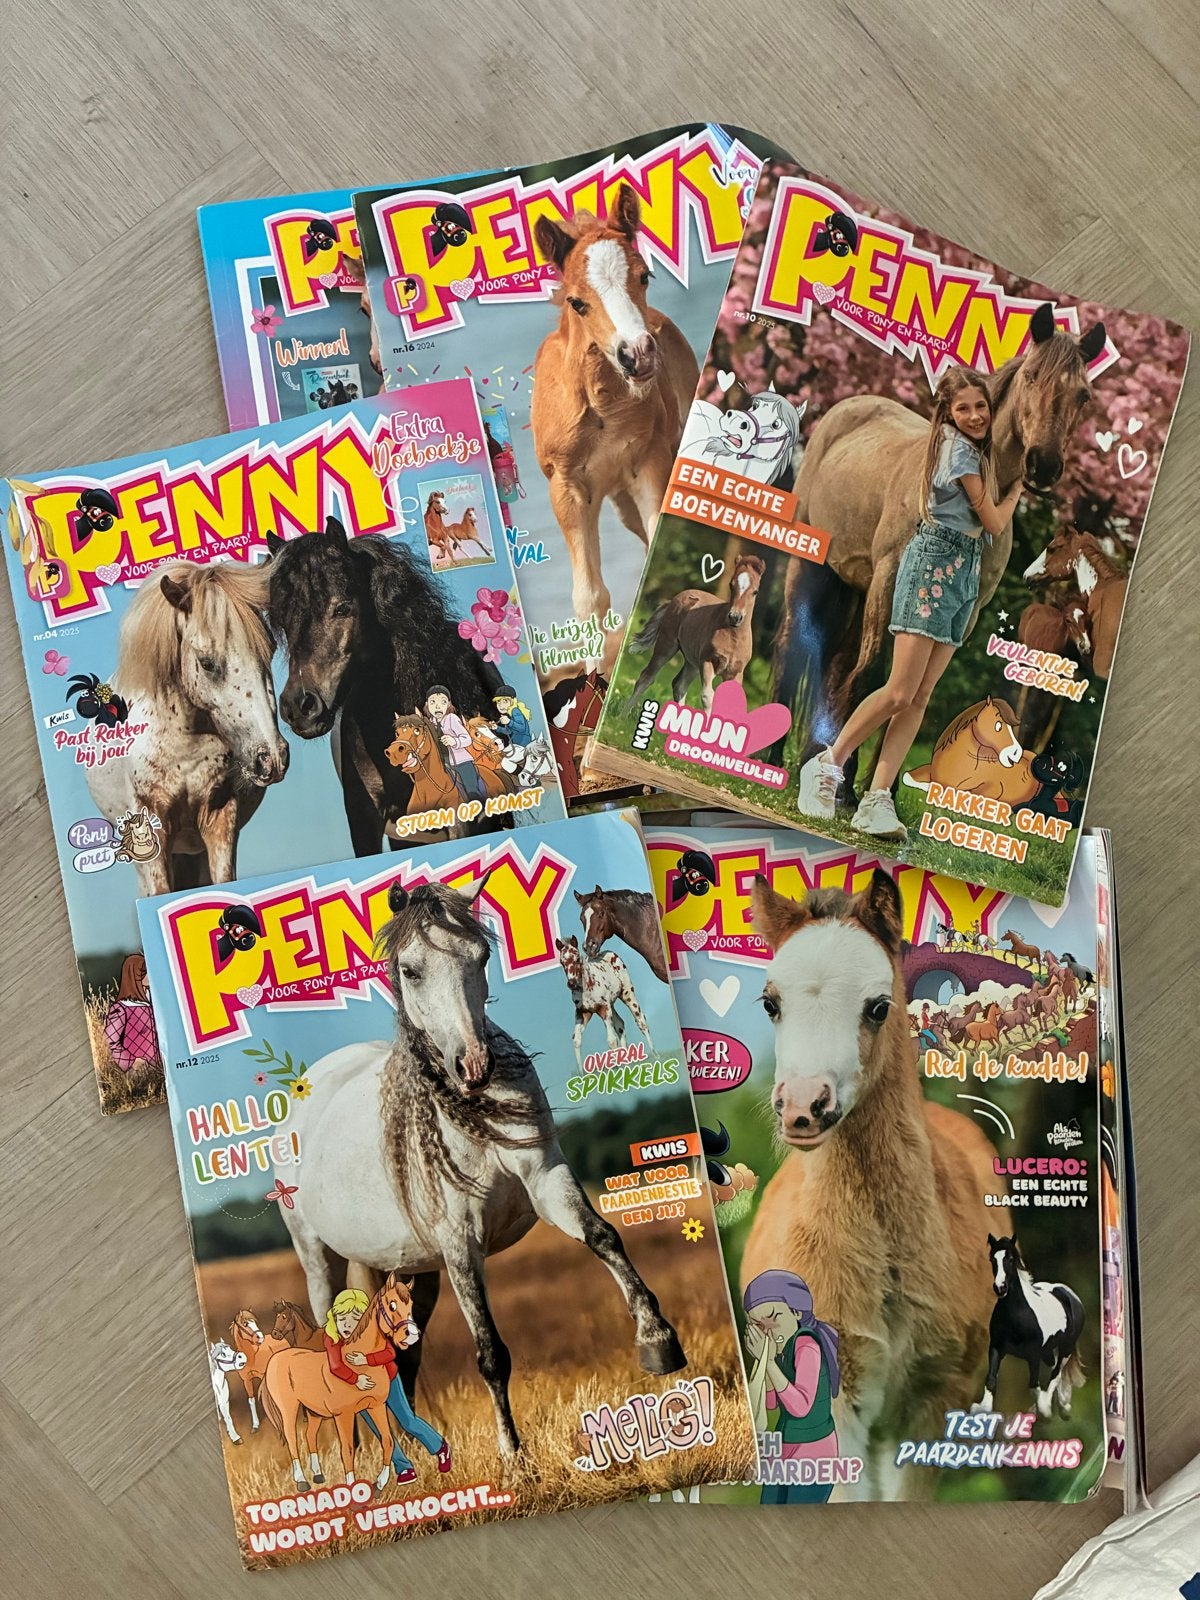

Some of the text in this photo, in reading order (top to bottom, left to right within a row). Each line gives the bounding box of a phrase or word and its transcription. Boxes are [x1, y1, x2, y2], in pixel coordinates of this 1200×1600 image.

[478, 265, 556, 294] VOOR PONY E
[762, 187, 1110, 372] PENN
[733, 310, 775, 330] nr.10 2025
[836, 299, 951, 352] VOOR PONY EN PAARD!
[276, 329, 350, 367] Winnen!
[392, 342, 435, 354] nr.16 2024
[391, 412, 443, 442] Extra
[373, 433, 480, 476] Doeboekje
[677, 464, 785, 514] EEN ECHTE
[25, 430, 398, 618] PENNY
[669, 491, 820, 557] BOEVENVANGER
[124, 562, 154, 578] VOOR
[193, 547, 209, 559] EN
[212, 533, 252, 553] PAARD!
[33, 627, 80, 642] nr.04 2025
[552, 615, 597, 644] krijgt
[604, 610, 621, 628] de
[540, 633, 603, 673] filmrol?
[989, 635, 1078, 675] VEULENTJE
[1005, 664, 1088, 701] GEBOREN!
[49, 712, 70, 726] Kwis
[634, 702, 659, 748] KWIS
[659, 704, 748, 753] MIJN
[55, 722, 148, 748] Past Rakker
[76, 738, 134, 767] bij jou?
[668, 738, 785, 785] DROOMVEULEN
[397, 788, 542, 835] STORM OP KOMST
[927, 783, 1071, 842] RAKKER GAAT
[71, 824, 108, 846] Pony
[920, 814, 1027, 862] LOGEREN
[79, 851, 110, 871] pret
[169, 855, 566, 1043] PENY
[711, 936, 768, 948] VOOR PO
[267, 984, 300, 1000] VOOR
[303, 974, 336, 991] PONY
[341, 970, 357, 982] EN
[175, 1055, 220, 1070] nr.12 2025
[583, 1044, 647, 1073] OVERAL
[687, 1039, 730, 1063] KER
[926, 1050, 1088, 1082] Red de kudde!
[567, 1058, 679, 1101] SPIKKELS
[688, 1065, 742, 1081] WEZEN!
[188, 1092, 289, 1143] HALLO
[1053, 1122, 1068, 1133] Als
[641, 1140, 687, 1160] KWIS
[1047, 1129, 1081, 1145] paarden
[193, 1131, 300, 1183] LENTE!
[993, 1157, 1087, 1176] LUCERO:
[605, 1165, 688, 1190] WAT VOOR
[1012, 1179, 1087, 1191] EEN ECHTE
[601, 1181, 699, 1210] PAARDENBESTIE
[984, 1194, 1088, 1208] BLACK BEAUTY
[623, 1202, 685, 1225] BEN JIJ?
[946, 1412, 1035, 1439] TEST JE
[898, 1439, 1082, 1470] PAARDENKENNIS
[760, 1458, 862, 1484] AARDEN?
[246, 1482, 371, 1525] TORNADO
[249, 1485, 511, 1553] WORDT VERKOCHT...
